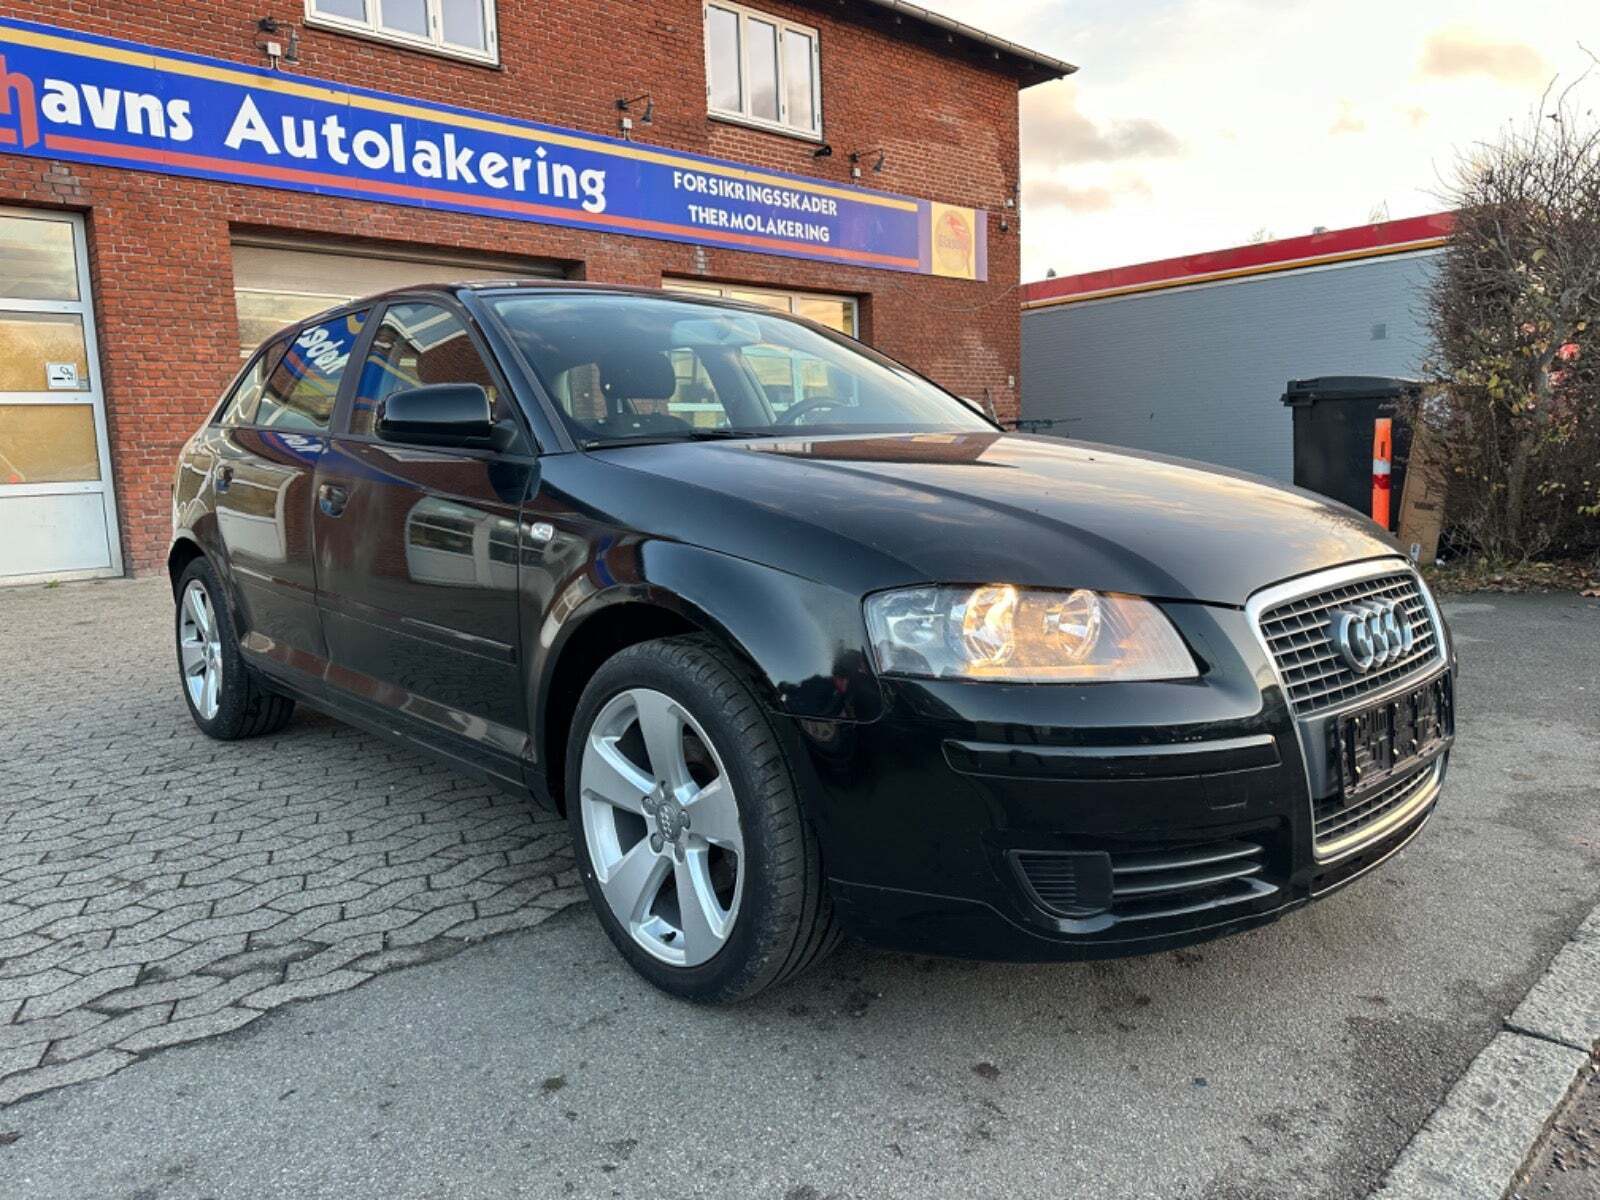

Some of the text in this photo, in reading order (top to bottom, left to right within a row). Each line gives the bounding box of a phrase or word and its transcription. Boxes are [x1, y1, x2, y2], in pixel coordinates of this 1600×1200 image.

[223, 93, 607, 214] Autolakering
[673, 170, 838, 217] FORSIKRINGSSKADER
[688, 205, 830, 243] THERMOLAKERING
